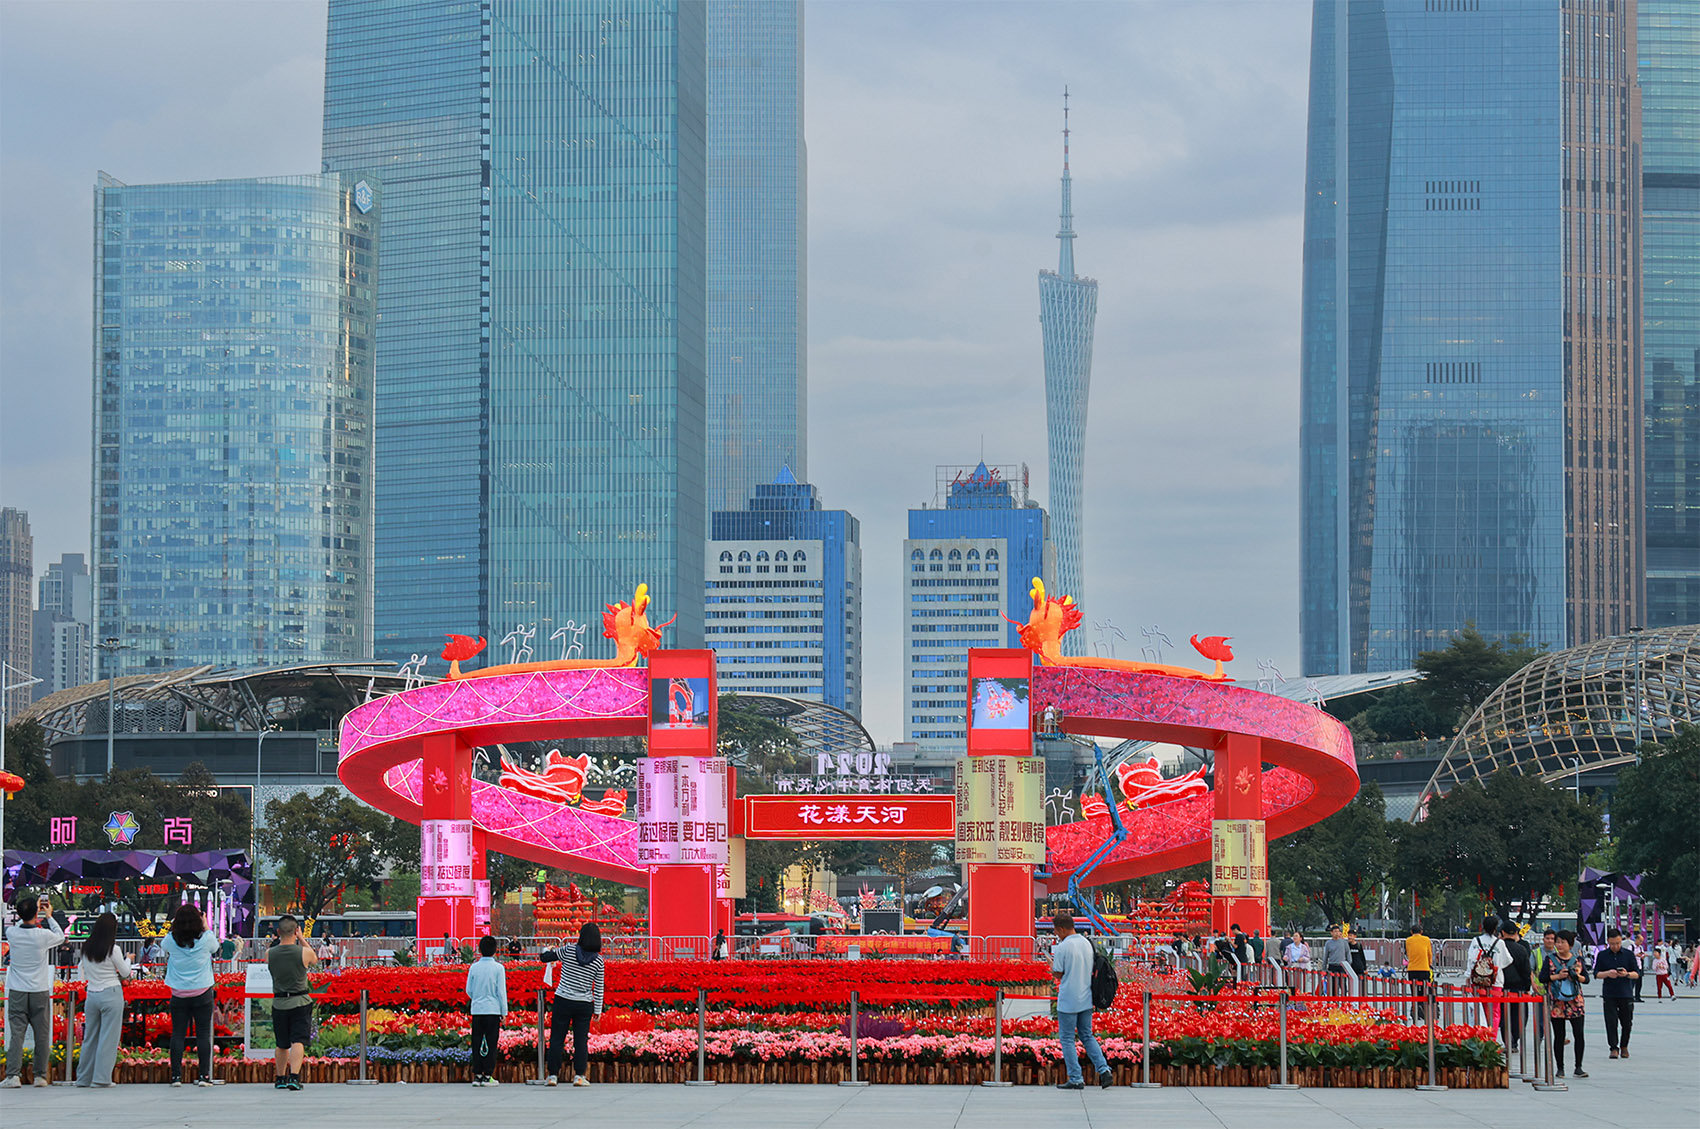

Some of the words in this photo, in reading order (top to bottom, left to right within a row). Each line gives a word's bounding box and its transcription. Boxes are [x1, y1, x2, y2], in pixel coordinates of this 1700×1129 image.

[356, 190, 371, 205] R&F
[681, 764, 690, 816] 一本万利
[797, 804, 908, 825] 花漾天河
[50, 815, 78, 845] 时
